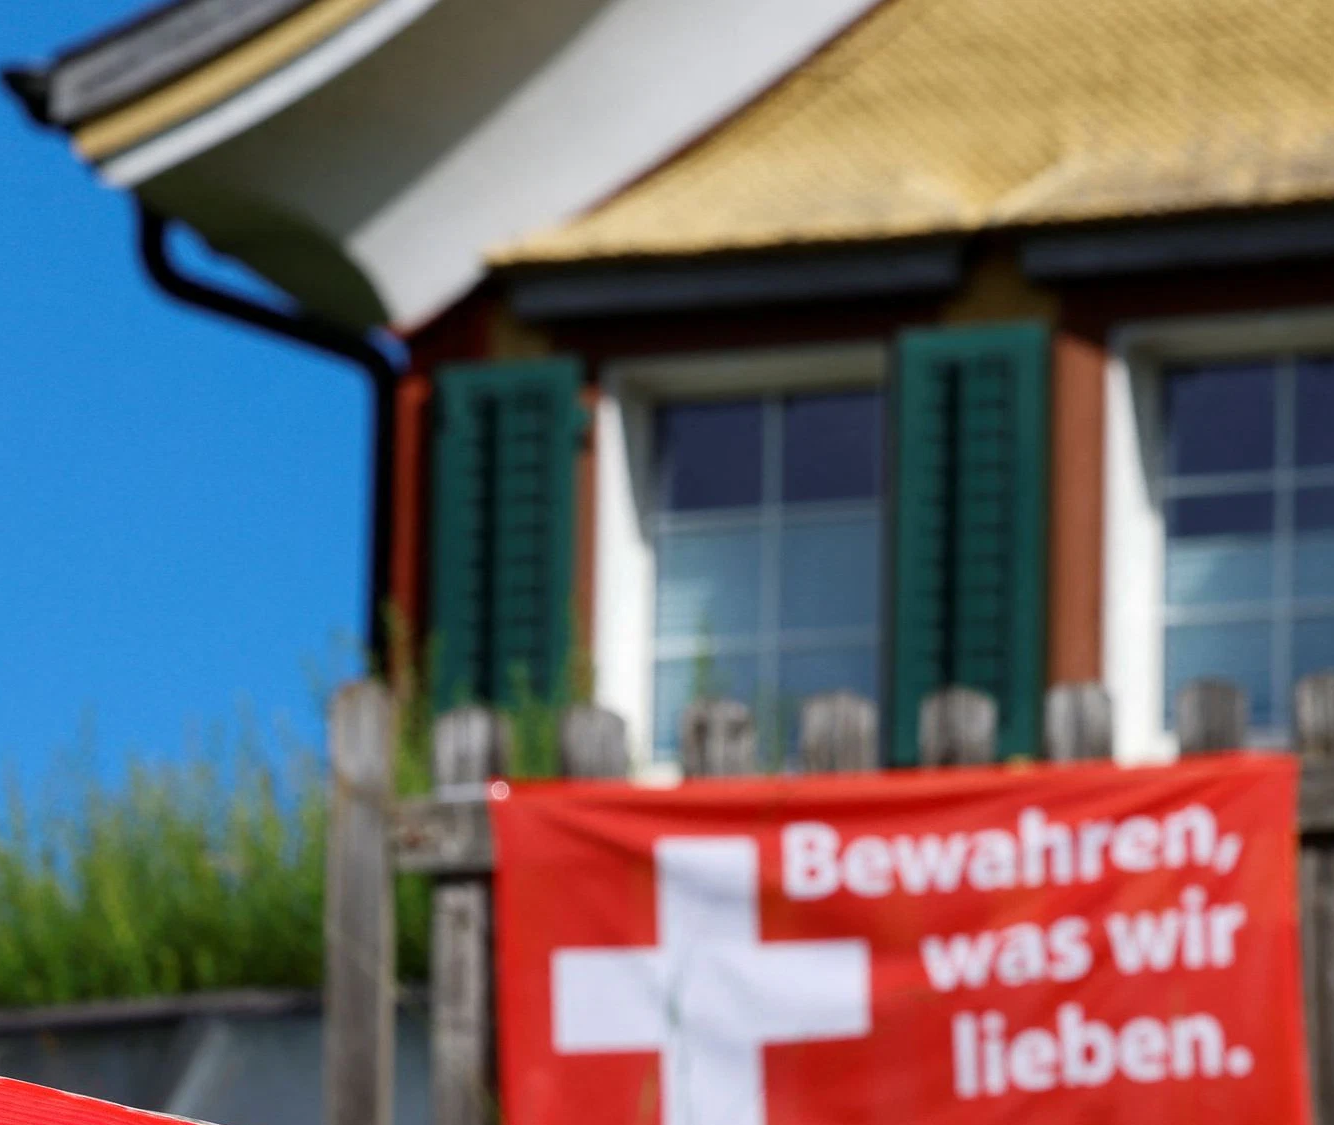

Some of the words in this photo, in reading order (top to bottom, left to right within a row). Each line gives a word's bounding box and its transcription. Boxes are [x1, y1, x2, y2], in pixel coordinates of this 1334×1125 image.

[779, 803, 1242, 900] Bewahren,
[920, 915, 1091, 992] was
[1104, 886, 1247, 975] wir
[952, 1003, 1253, 1099] lieben.
